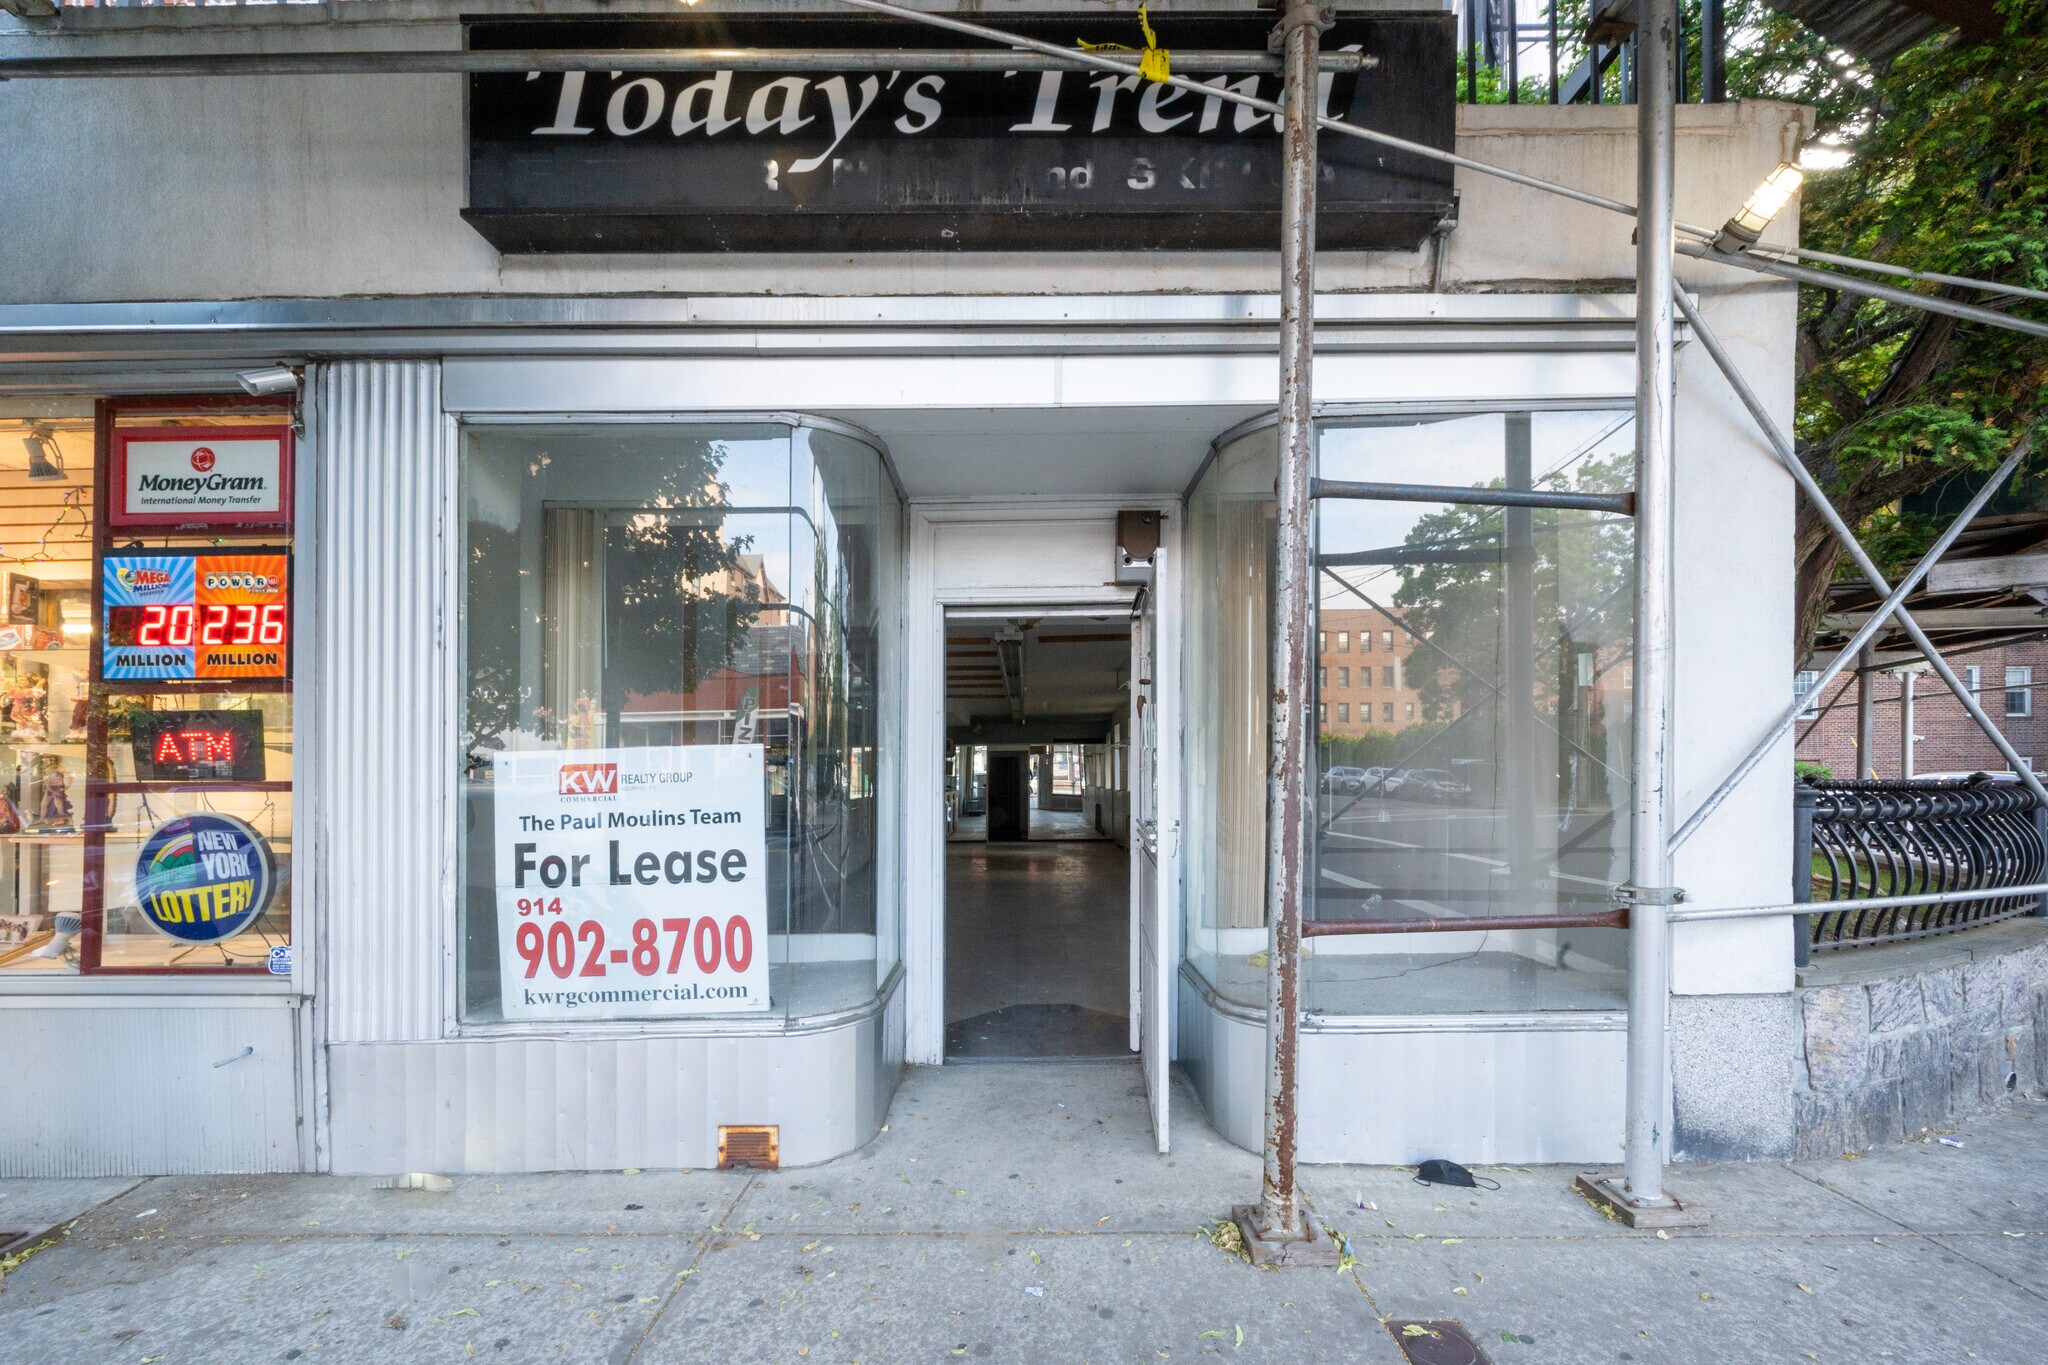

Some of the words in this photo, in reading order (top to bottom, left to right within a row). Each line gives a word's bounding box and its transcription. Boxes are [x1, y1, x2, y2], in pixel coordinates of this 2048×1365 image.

[526, 70, 946, 173] Today's
[138, 473, 264, 495] MoneyGram
[141, 496, 196, 505] International
[198, 496, 227, 506] Money
[228, 495, 262, 504] Transfer
[133, 570, 171, 585] MEGA
[140, 605, 193, 645] 20
[202, 605, 284, 645] 236
[115, 654, 187, 667] MILLION
[206, 653, 278, 666] MILLION
[158, 732, 232, 761] ATM
[560, 769, 617, 794] KW
[621, 773, 657, 785] REALTY
[659, 771, 693, 784] GROUP
[560, 795, 618, 804] COMMERCIAL
[519, 815, 555, 832] The
[560, 812, 602, 831] Paul
[608, 810, 686, 829] Moulins
[690, 808, 742, 825] Team
[197, 831, 237, 852] NEW
[200, 852, 251, 881] YORK
[514, 842, 591, 889] For
[608, 839, 748, 886] Lease
[150, 878, 255, 924] LOTTERY
[516, 897, 563, 917] 914
[516, 914, 753, 979] 902-8700
[523, 983, 749, 1008] kwrgcommercial.com
